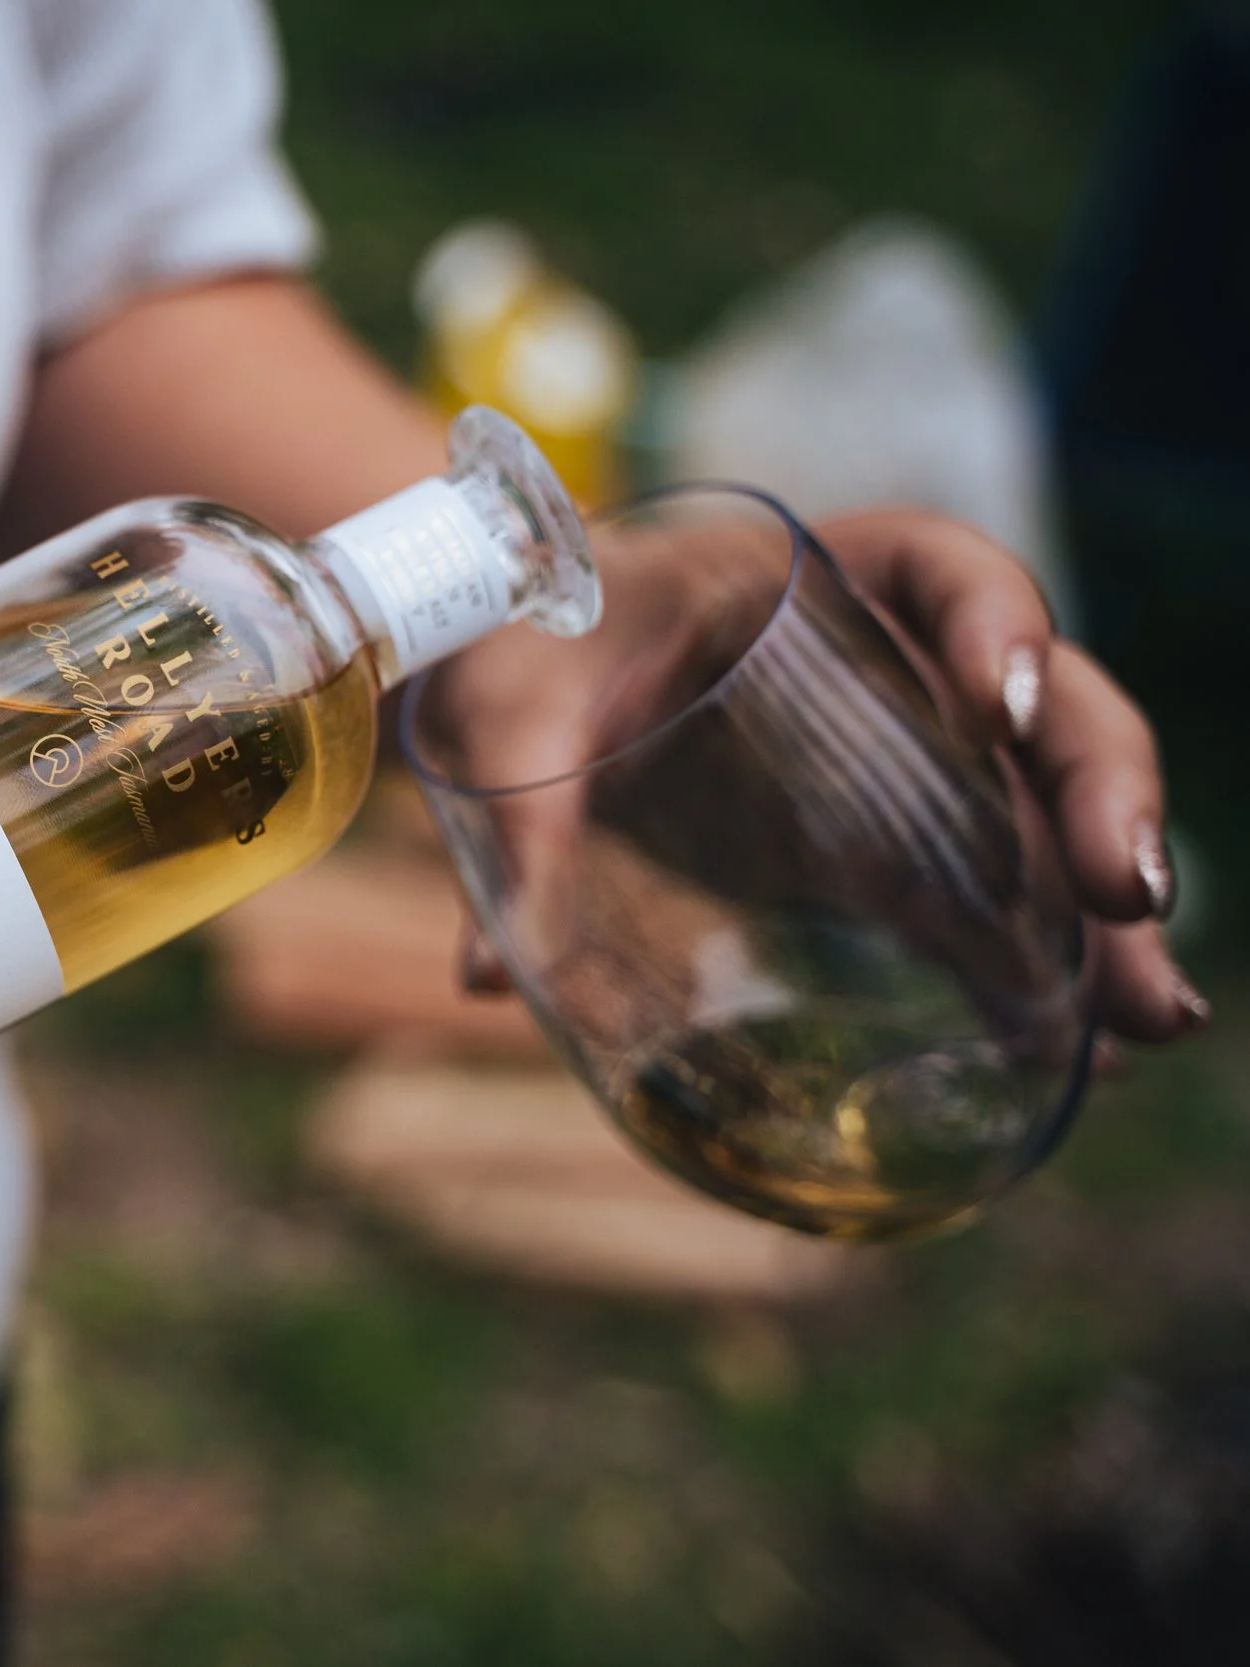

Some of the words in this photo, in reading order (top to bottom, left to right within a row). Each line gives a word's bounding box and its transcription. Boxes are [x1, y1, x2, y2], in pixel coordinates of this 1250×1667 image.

[27, 622, 90, 682] North
[72, 680, 126, 745] West
[90, 550, 266, 845] HELLYERS
[94, 631, 195, 793] ROAD
